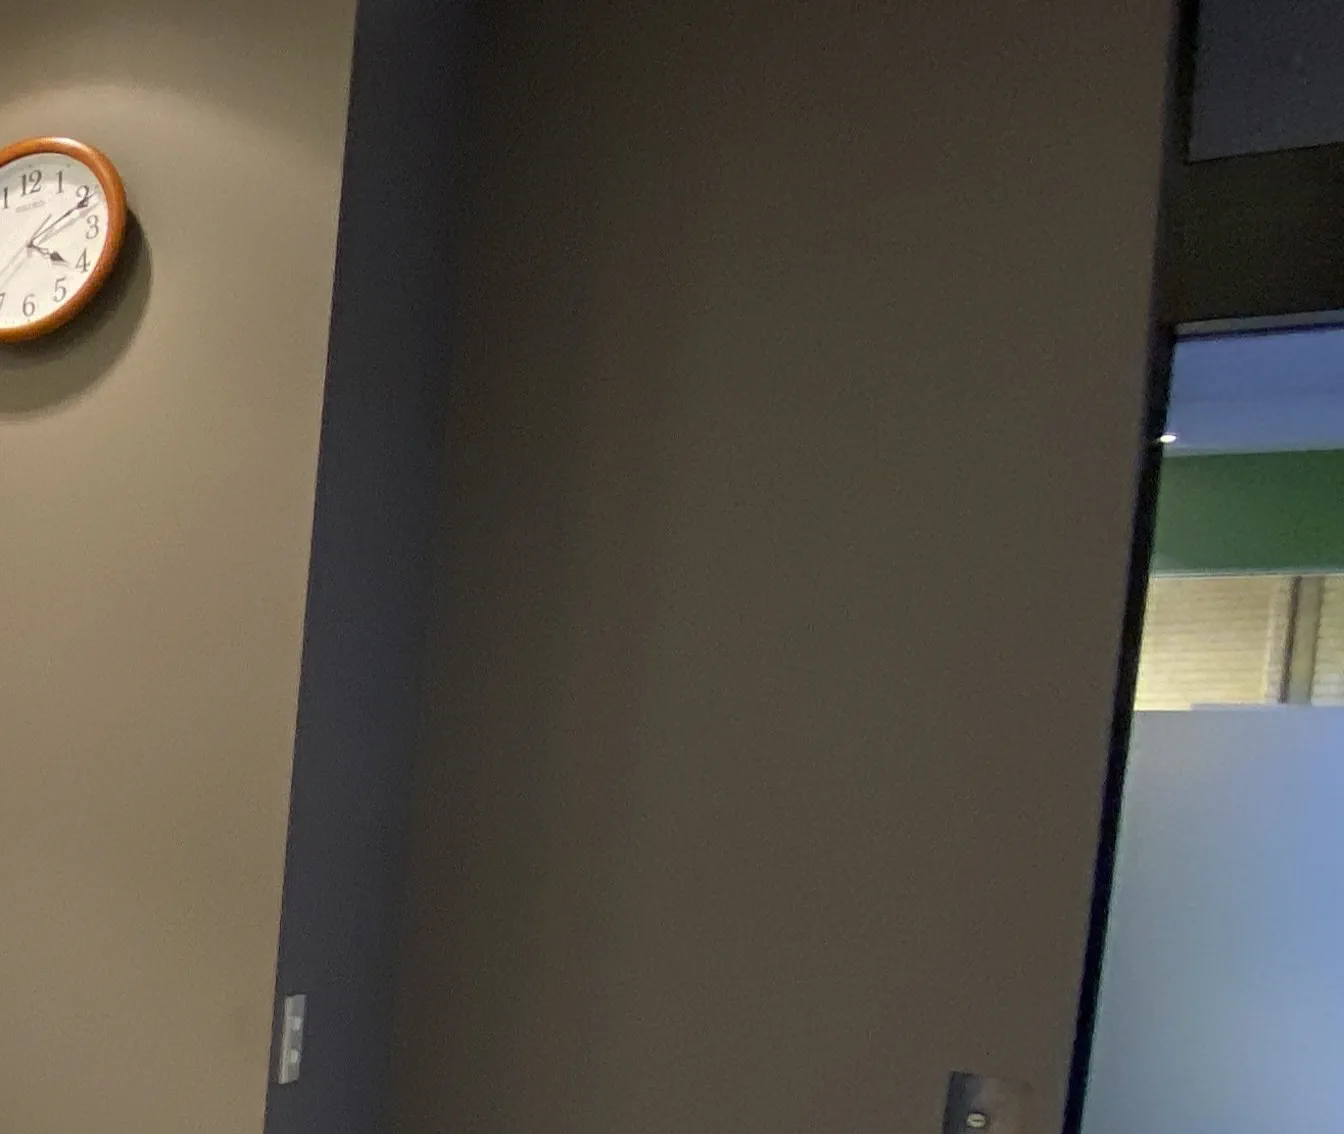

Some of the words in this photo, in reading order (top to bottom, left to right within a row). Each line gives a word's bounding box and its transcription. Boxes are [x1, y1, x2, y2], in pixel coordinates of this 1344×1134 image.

[20, 170, 42, 196] 12
[56, 170, 64, 194] 1
[76, 185, 92, 208] 2
[86, 215, 100, 240] 3
[76, 248, 90, 273] 4
[52, 276, 68, 303] 5
[22, 294, 36, 317] 6
